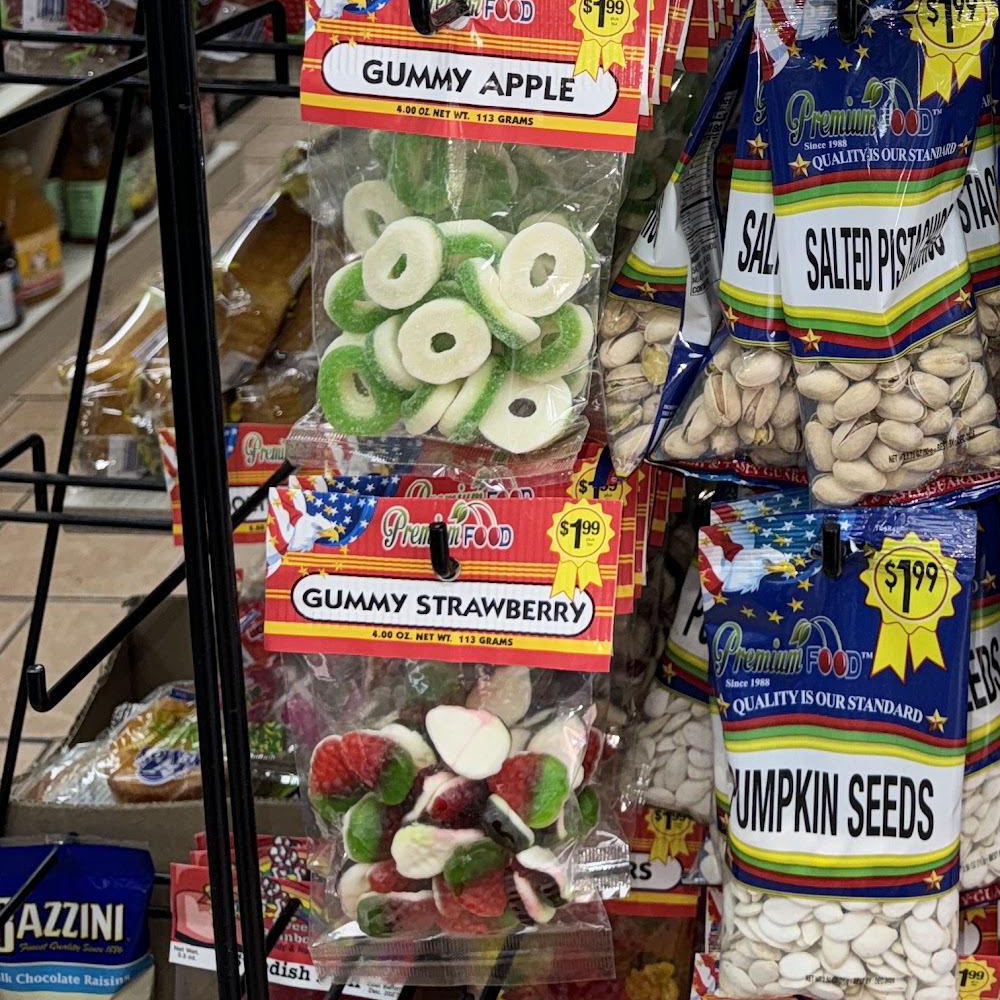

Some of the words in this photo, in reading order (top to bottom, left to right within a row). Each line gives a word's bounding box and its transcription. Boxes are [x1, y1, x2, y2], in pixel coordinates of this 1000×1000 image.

[362, 58, 472, 93] GUMMY
[479, 70, 576, 102] APPLE
[396, 104, 418, 115] 4.00
[432, 108, 451, 118] NET
[453, 110, 470, 120] WT.
[476, 112, 495, 123] 113
[497, 114, 534, 126] GRAMS
[785, 89, 876, 147] Premium
[804, 140, 826, 151] Since
[827, 139, 848, 150] 1988
[812, 149, 868, 170] QUALITY
[868, 149, 880, 162] IS
[881, 148, 907, 162] OUR
[908, 142, 957, 162] STANDARD
[805, 227, 873, 291] SALTED
[464, 525, 513, 551] FOOD
[302, 587, 407, 614] GUMMY
[416, 594, 587, 625] STRAWBERRY
[372, 629, 394, 640] 4.00
[396, 630, 414, 641] OZ.
[416, 632, 435, 643] NET
[436, 633, 453, 644] WT.
[458, 635, 476, 646] 113
[478, 636, 514, 648] GRAMS
[712, 620, 803, 678] Premium
[805, 645, 862, 680] FOOD
[725, 678, 749, 689] Since
[750, 677, 770, 688] 1988
[732, 689, 799, 716] QUALITY
[800, 689, 814, 706] IS
[815, 691, 845, 709] OUR
[846, 696, 924, 725] STANDARD
[847, 773, 935, 841] SEEDS
[16, 972, 80, 985] Chocolate
